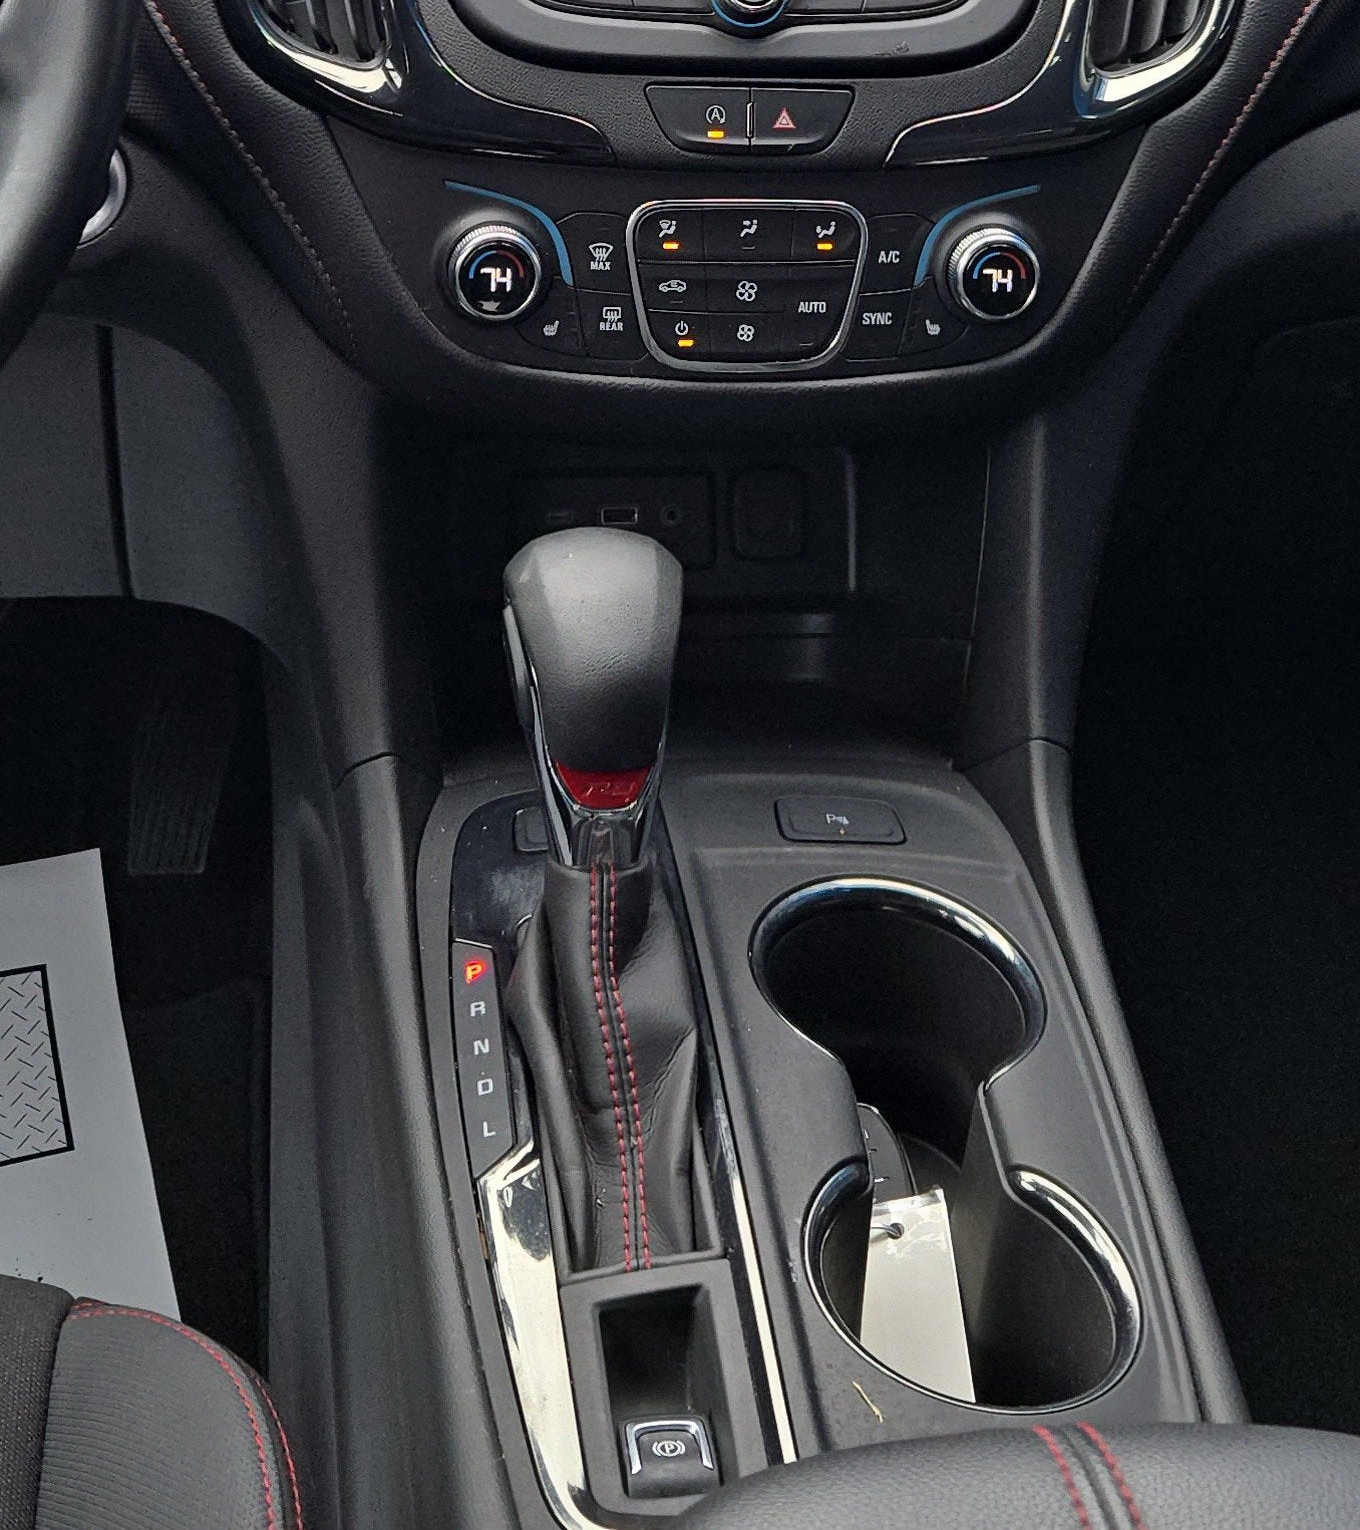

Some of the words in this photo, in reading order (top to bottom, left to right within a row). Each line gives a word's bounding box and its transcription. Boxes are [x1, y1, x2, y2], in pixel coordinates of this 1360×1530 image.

[878, 250, 900, 263] A/C
[590, 261, 611, 271] MAX
[480, 267, 512, 293] 74
[982, 268, 1013, 293] 74
[798, 301, 827, 313] AUTO
[600, 322, 624, 331] REAR
[862, 312, 892, 325] SYNC
[465, 962, 483, 984] P
[470, 1000, 486, 1017] R
[473, 1038, 490, 1055] N
[477, 1078, 494, 1096] D
[483, 1121, 496, 1138] L
